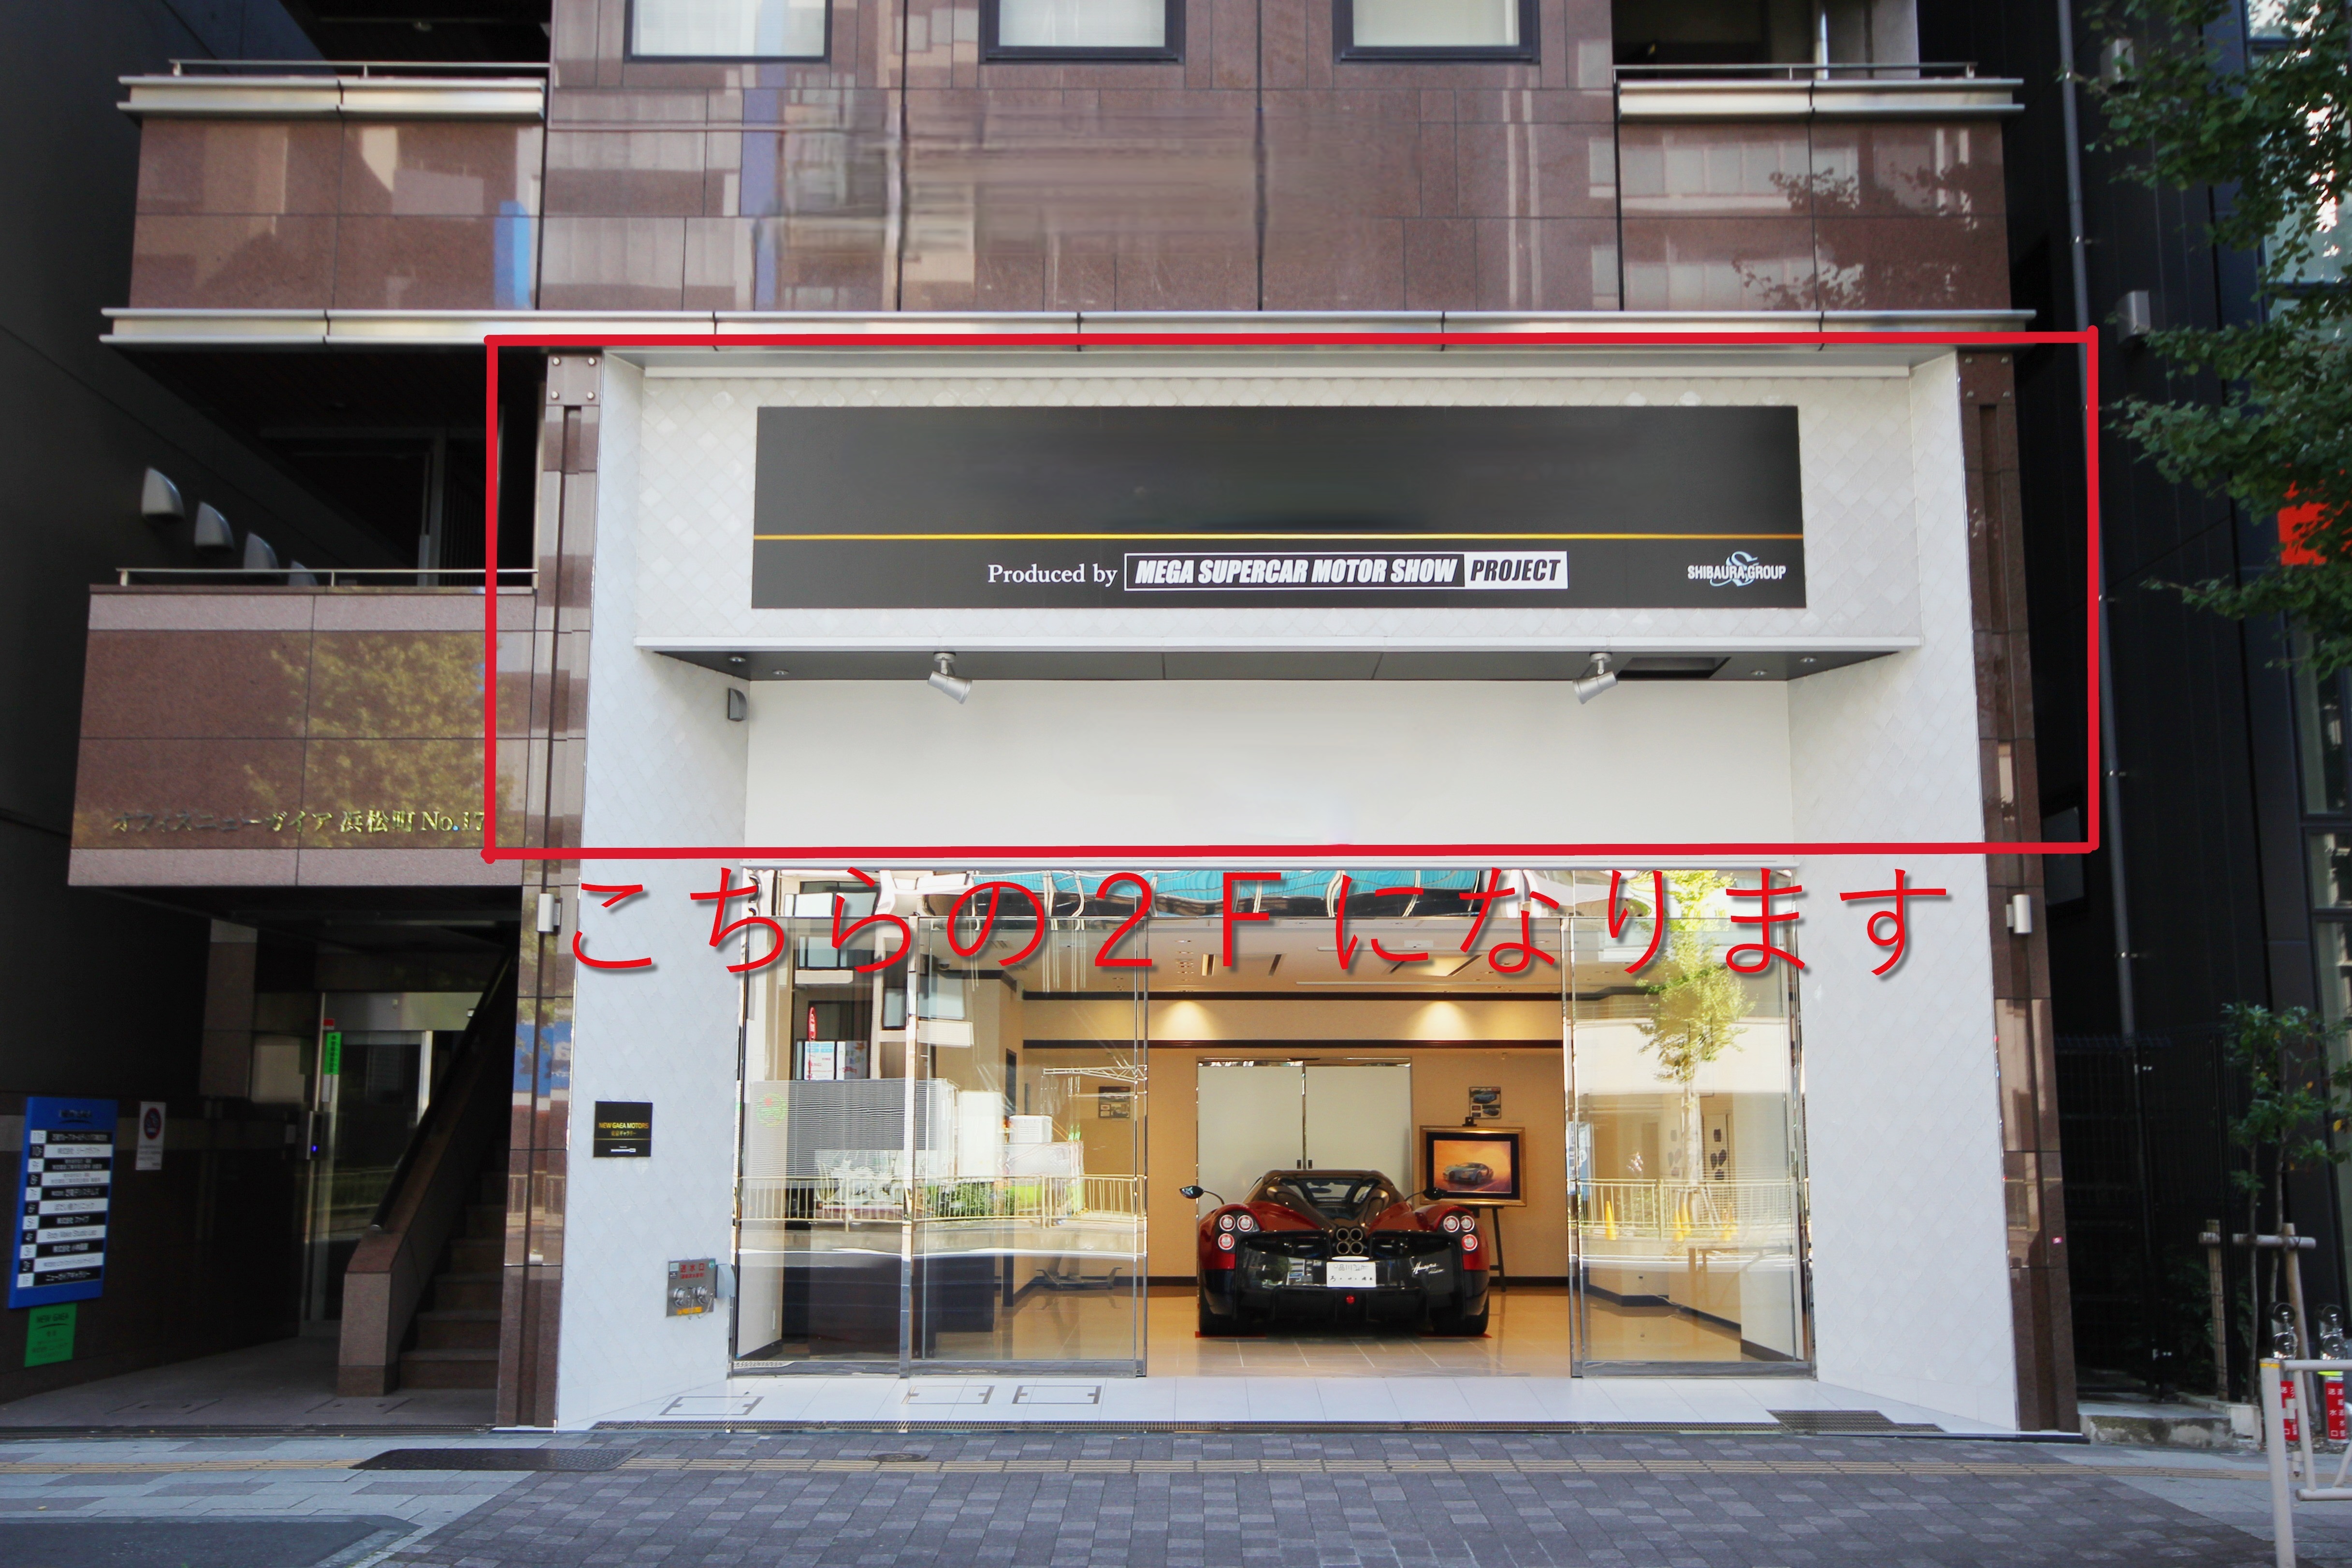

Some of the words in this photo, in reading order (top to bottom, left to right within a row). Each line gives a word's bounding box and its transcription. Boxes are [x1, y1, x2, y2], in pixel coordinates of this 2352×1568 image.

[987, 563, 1086, 583] Produced
[1092, 563, 1118, 587] by
[1134, 559, 1195, 584] MEGA
[1198, 559, 1309, 584] SUPERCAR
[1311, 558, 1388, 583] MOTOR
[1390, 558, 1458, 583] SHOW
[1469, 559, 1561, 581] PROJECT
[1687, 565, 1745, 580] SHIBAURA
[1746, 565, 1787, 580] GROUP
[340, 809, 416, 833] 浜松町
[420, 811, 484, 832] No.17
[2327, 1388, 2338, 1437] 送水口
